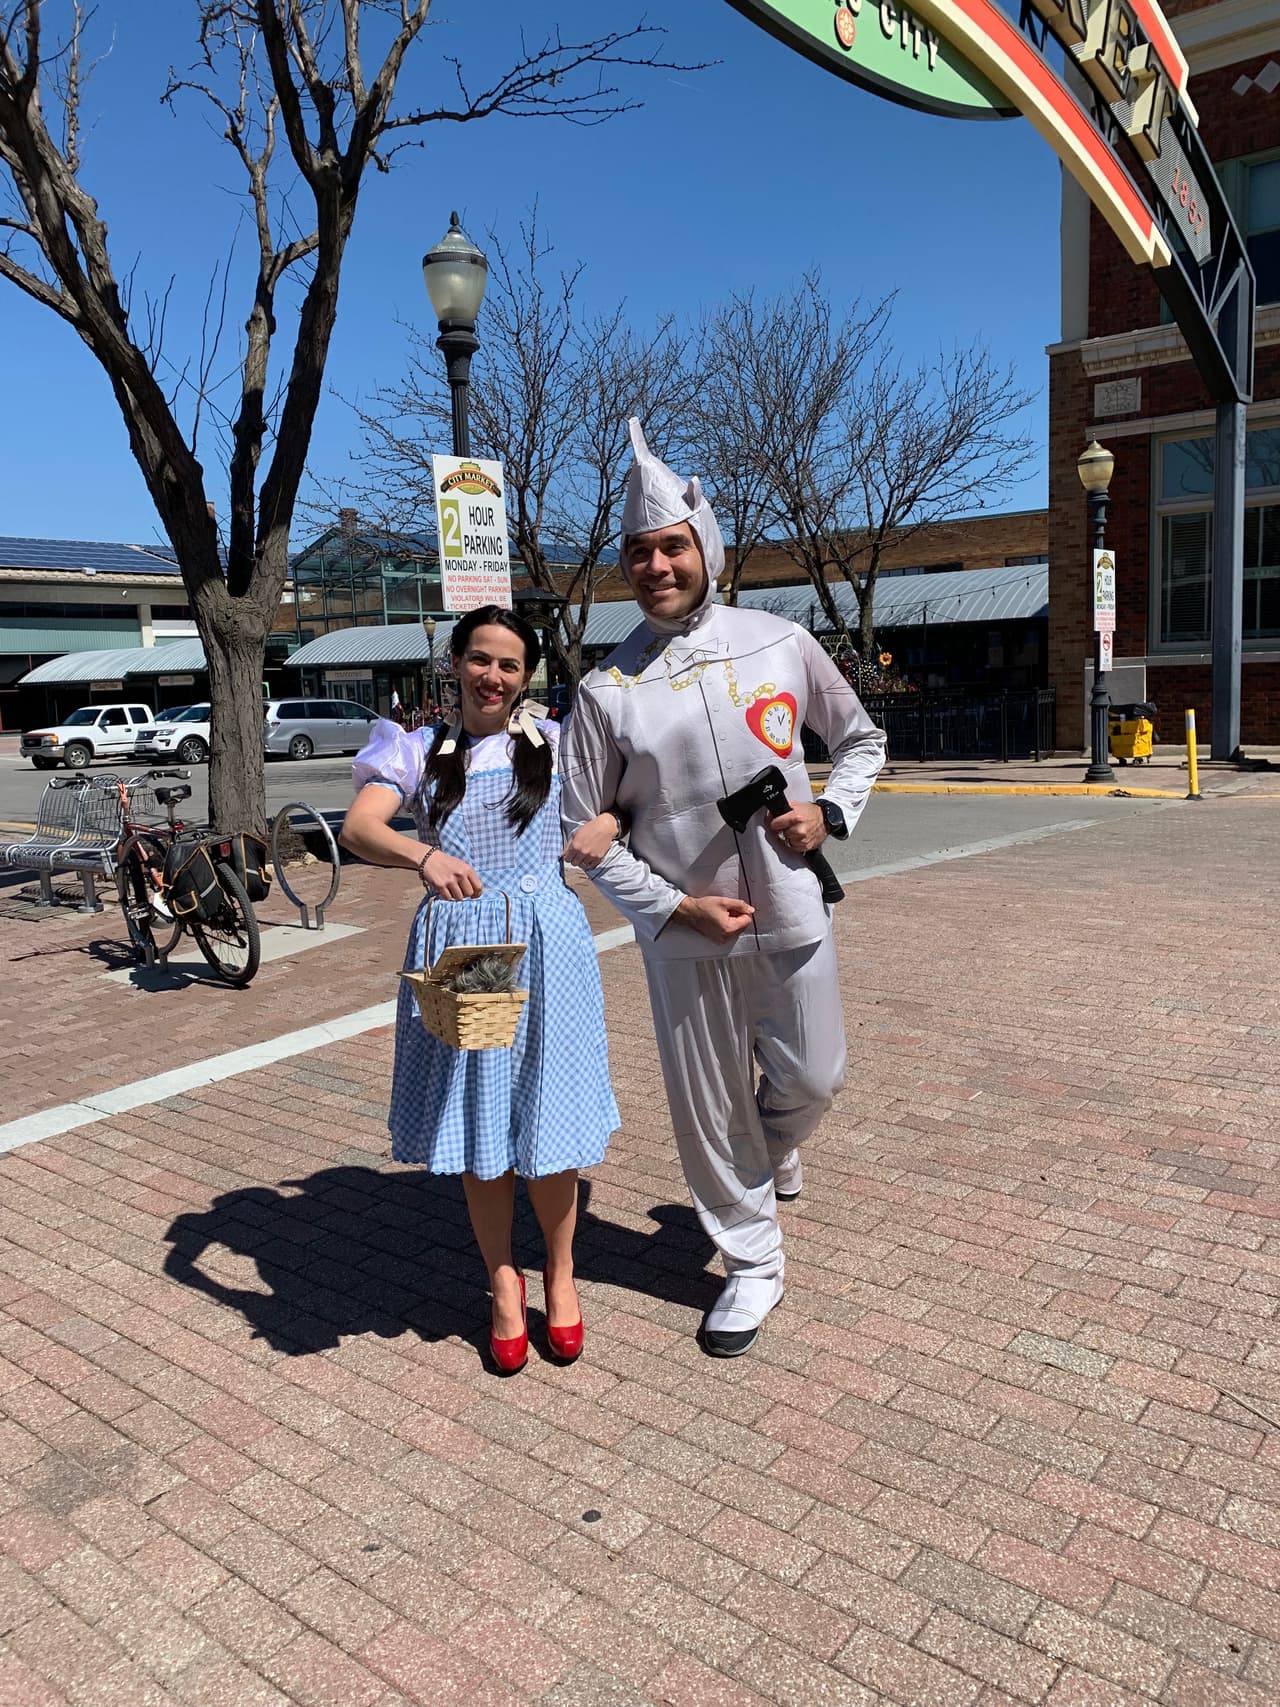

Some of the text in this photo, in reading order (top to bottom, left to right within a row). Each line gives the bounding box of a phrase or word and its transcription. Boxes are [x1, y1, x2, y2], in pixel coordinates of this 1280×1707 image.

[879, 0, 939, 72] CITY
[1171, 165, 1204, 235] 1857
[448, 472, 494, 489] CITY MARKET
[443, 506, 461, 547] 2
[468, 505, 495, 527] HOUR
[463, 534, 503, 556] PARKING
[445, 559, 478, 572] MONDAY
[483, 560, 508, 573] FRIDAY
[446, 585, 511, 594] NO OVERNIGHT PARKING
[447, 575, 457, 583] NO
[458, 575, 481, 583] PARKING
